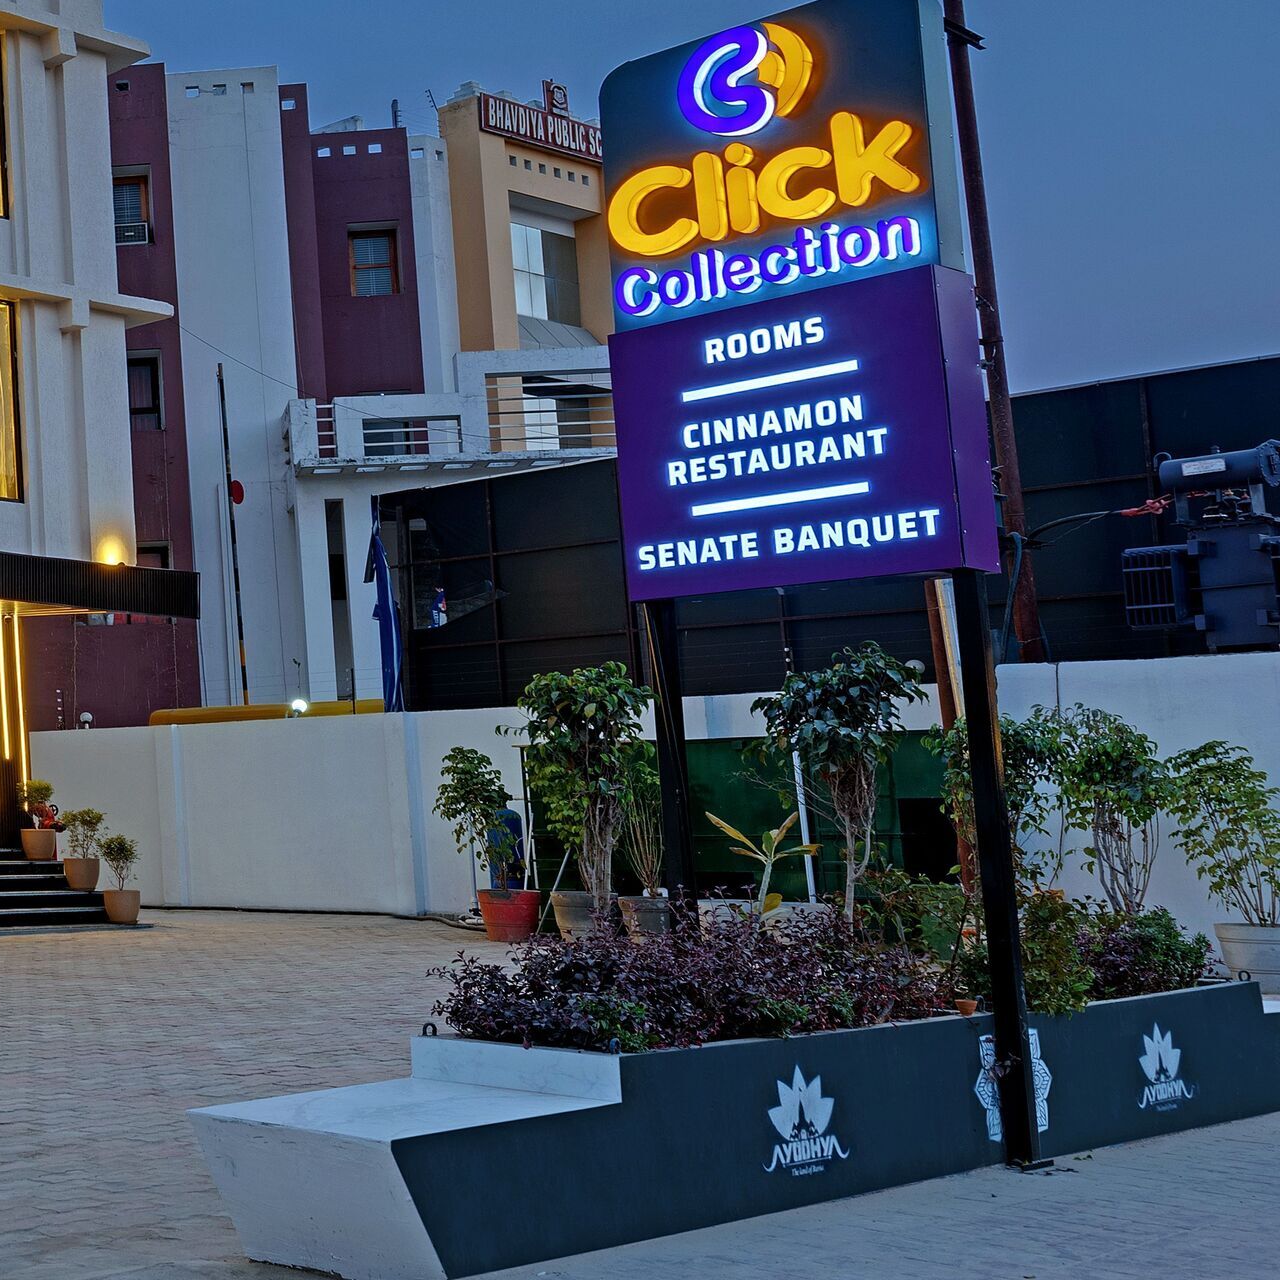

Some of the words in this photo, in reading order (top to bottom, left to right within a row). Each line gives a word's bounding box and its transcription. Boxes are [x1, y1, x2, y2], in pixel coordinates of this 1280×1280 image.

[488, 97, 545, 141] BHAVDIYA
[547, 115, 586, 152] PUBLIC
[608, 111, 920, 255] Click
[615, 215, 921, 317] Collection
[705, 316, 825, 364] ROOMS
[682, 394, 863, 449] CINNAMON
[667, 427, 888, 487] RESTAURANT
[638, 532, 760, 571] SENATE
[773, 508, 941, 555] BANQUET
[762, 1135, 850, 1172] AYODHYA
